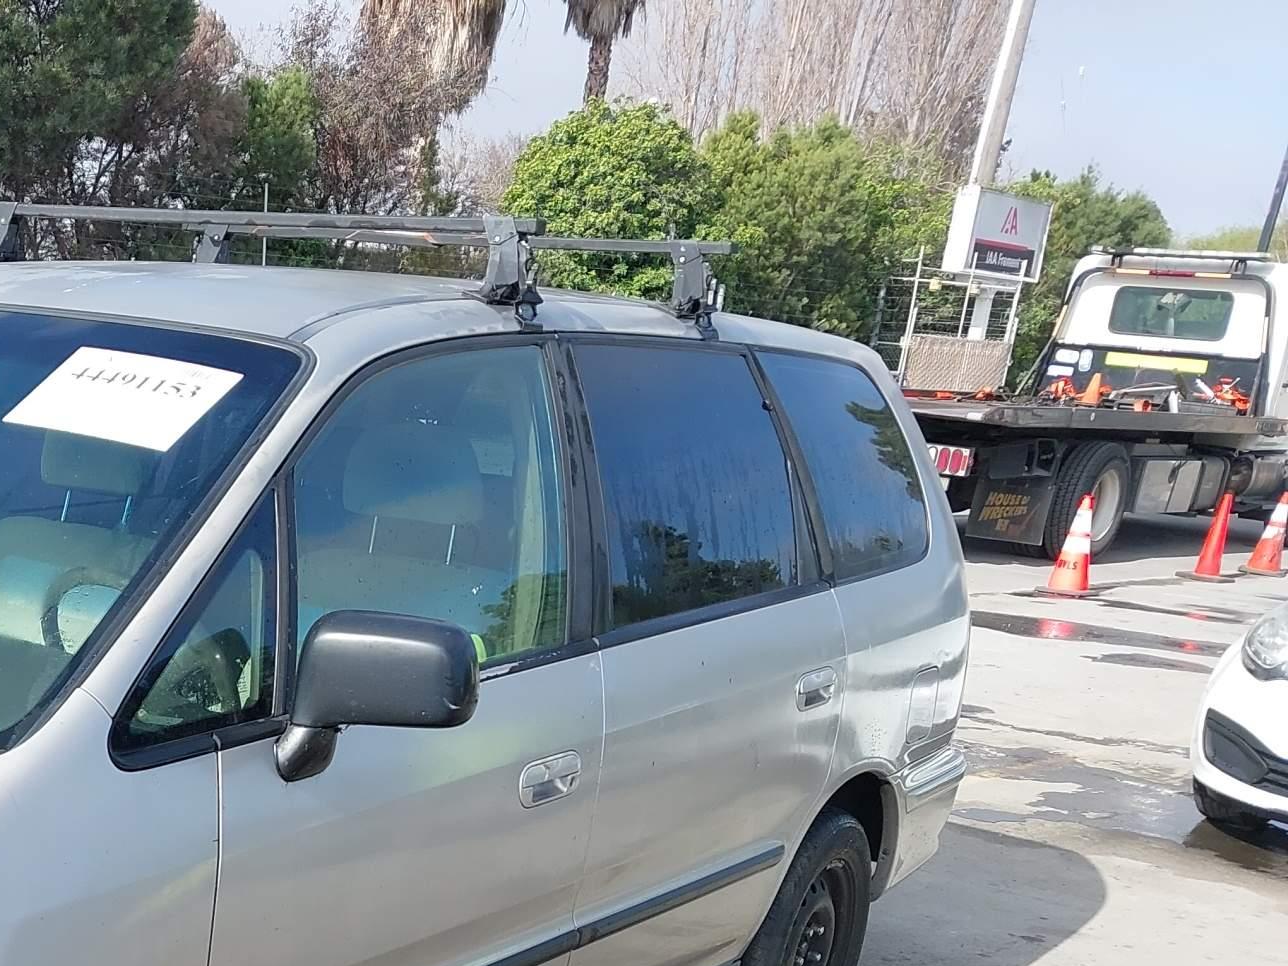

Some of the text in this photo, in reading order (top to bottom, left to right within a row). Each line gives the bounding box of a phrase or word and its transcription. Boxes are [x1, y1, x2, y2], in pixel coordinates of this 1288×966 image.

[71, 367, 202, 398] 44491153
[985, 491, 1022, 506] HOUSE
[977, 505, 1028, 522] WRECKERS
